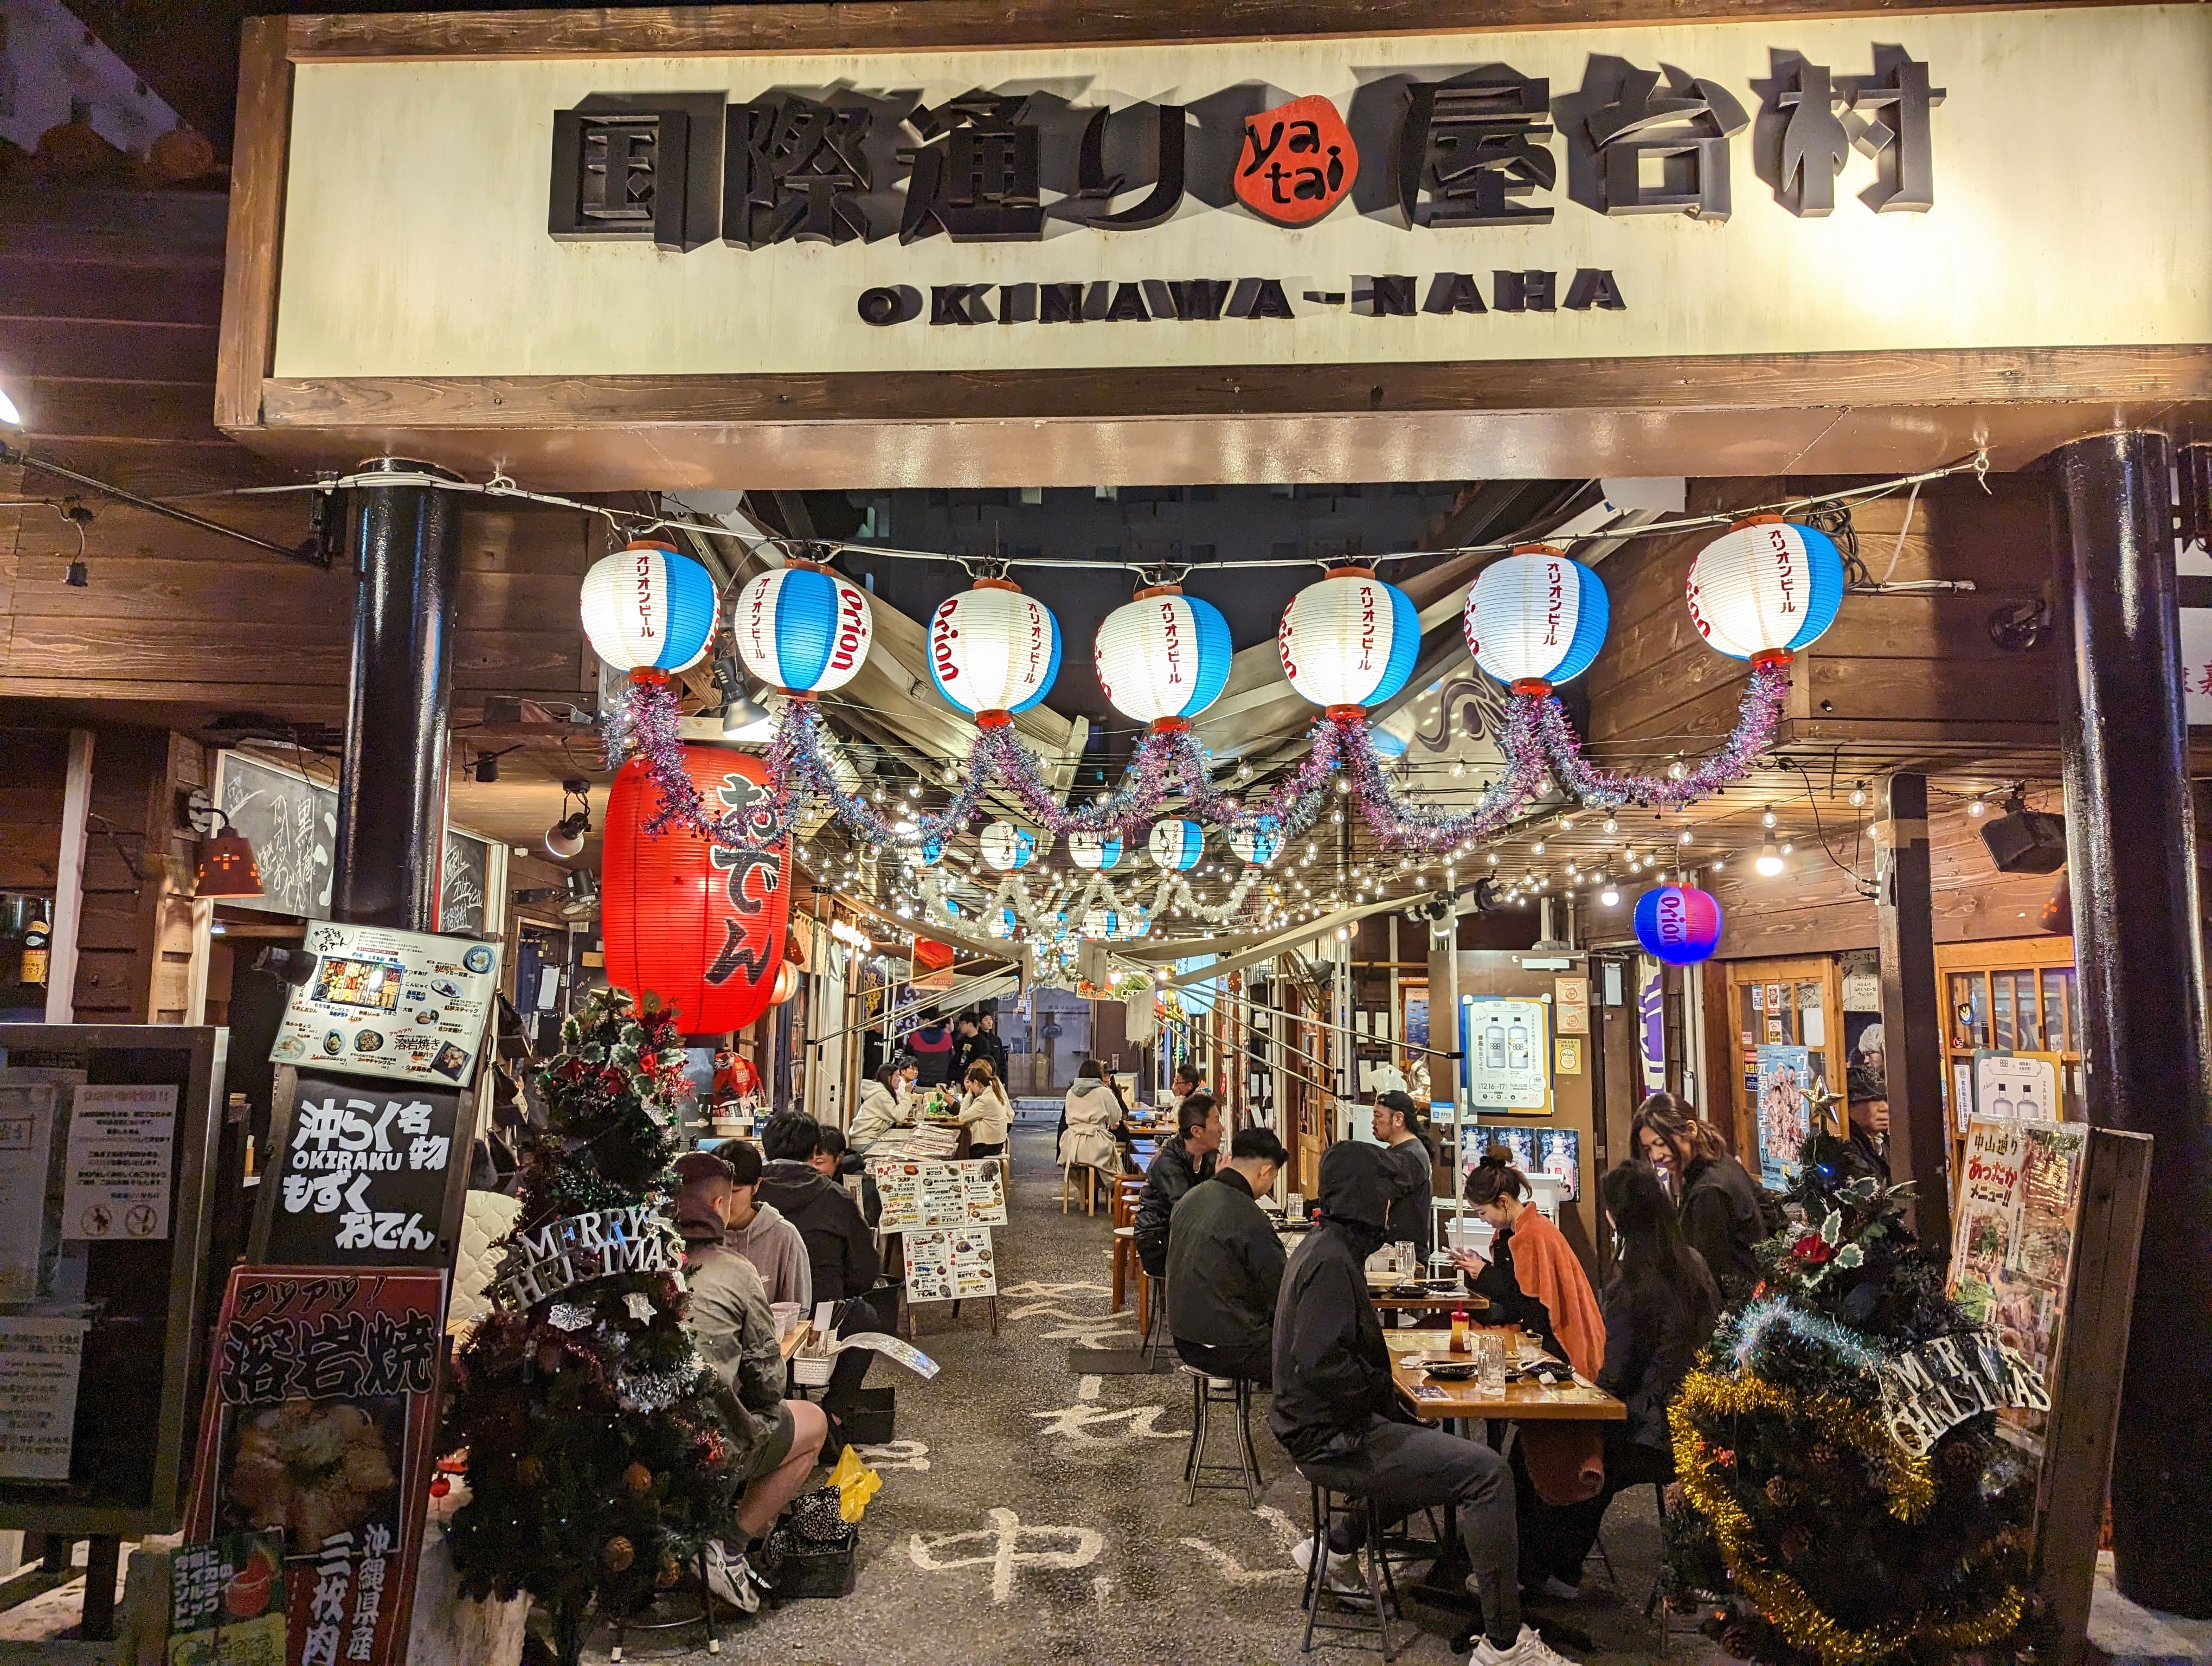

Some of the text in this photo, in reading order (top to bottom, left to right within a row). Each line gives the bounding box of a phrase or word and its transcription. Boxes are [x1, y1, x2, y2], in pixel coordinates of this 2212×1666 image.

[548, 61, 1947, 253] 国際通り 屋台村
[1265, 144, 1344, 206] tai
[635, 555, 655, 638] オリオンビール
[1542, 562, 1564, 646] オリオンビール
[1766, 528, 1797, 614] オリオンビール
[751, 577, 771, 659] オリオンビール
[831, 587, 870, 671] Orion
[933, 598, 960, 682] Orion
[1023, 601, 1054, 684] オリオンビール
[1159, 603, 1182, 684] オリオンビール
[1356, 586, 1375, 671] オリオンビール
[318, 937, 348, 952] おでん
[1660, 895, 1686, 946] Orion
[394, 1037, 441, 1050] 溶岩焼き
[291, 1098, 402, 1151] 沖らく
[292, 1150, 403, 1171] OKIRAKU
[283, 1169, 372, 1214] もずく
[1967, 1154, 2018, 1189] あったか
[335, 1211, 435, 1250] おでん
[517, 1204, 650, 1267] MERRY
[220, 1309, 435, 1405] 溶岩焼
[346, 1522, 390, 1662] 沖縄県産
